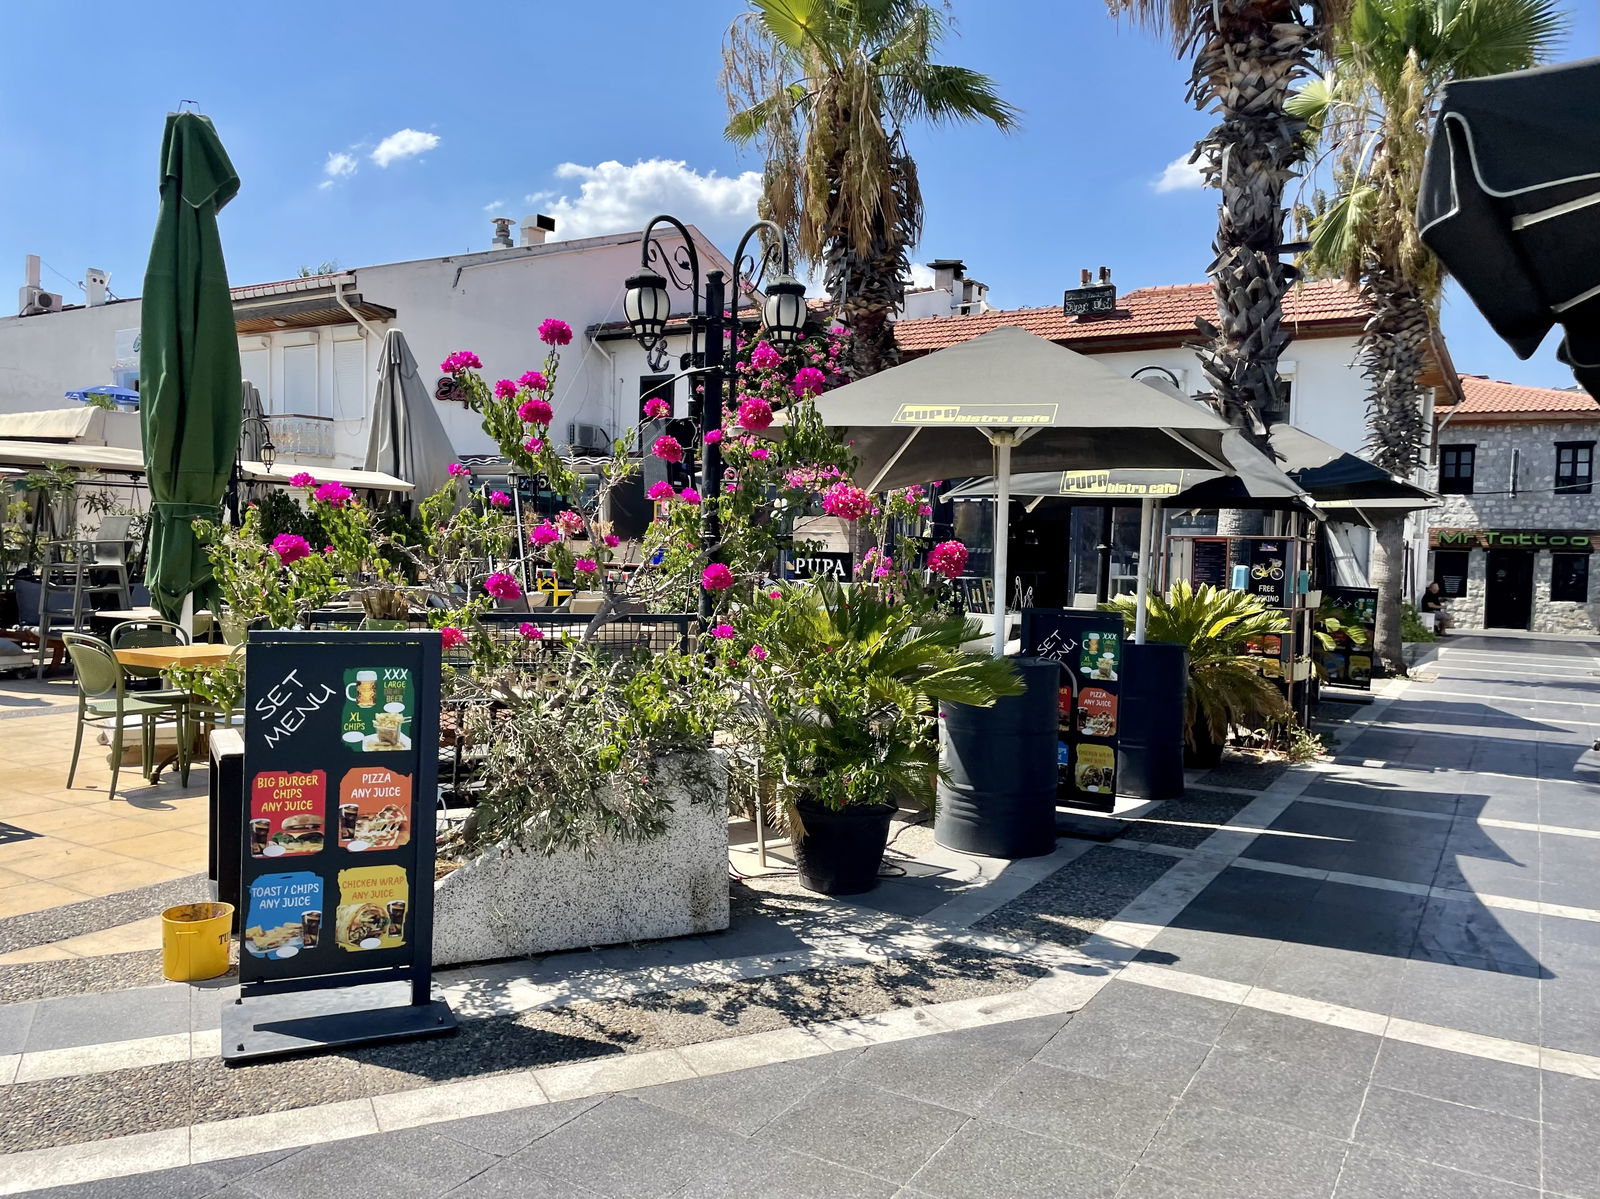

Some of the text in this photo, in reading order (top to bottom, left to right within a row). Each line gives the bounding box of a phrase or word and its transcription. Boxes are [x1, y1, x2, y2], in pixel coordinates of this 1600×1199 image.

[900, 408, 1050, 423] PUPA bistro cafe
[1065, 474, 1178, 494] PUPA bistro cafe
[1483, 531, 1590, 546] Tattoo
[794, 557, 846, 576] PUPA
[1258, 584, 1275, 593] FREE
[1036, 629, 1061, 656] SET
[1102, 632, 1117, 640] XXX
[1048, 638, 1078, 661] ENU
[384, 668, 408, 680] XXX
[383, 680, 406, 689] LARGE
[255, 669, 303, 720] SET
[264, 683, 337, 749] MENU
[349, 711, 361, 722] XL
[343, 722, 365, 731] CHIPS
[257, 775, 318, 788] BIG BURGER
[361, 773, 391, 783] PIZZA
[273, 788, 302, 798] CHIPS
[350, 786, 401, 798] ANY JUICE
[261, 800, 313, 812] ANY JUICE
[341, 876, 404, 889] CHICKEN WRAP
[251, 885, 282, 897] TOAST
[291, 883, 319, 895] CHIPS
[351, 888, 393, 899] ANY JUICE
[259, 896, 311, 909] ANY JUICE
